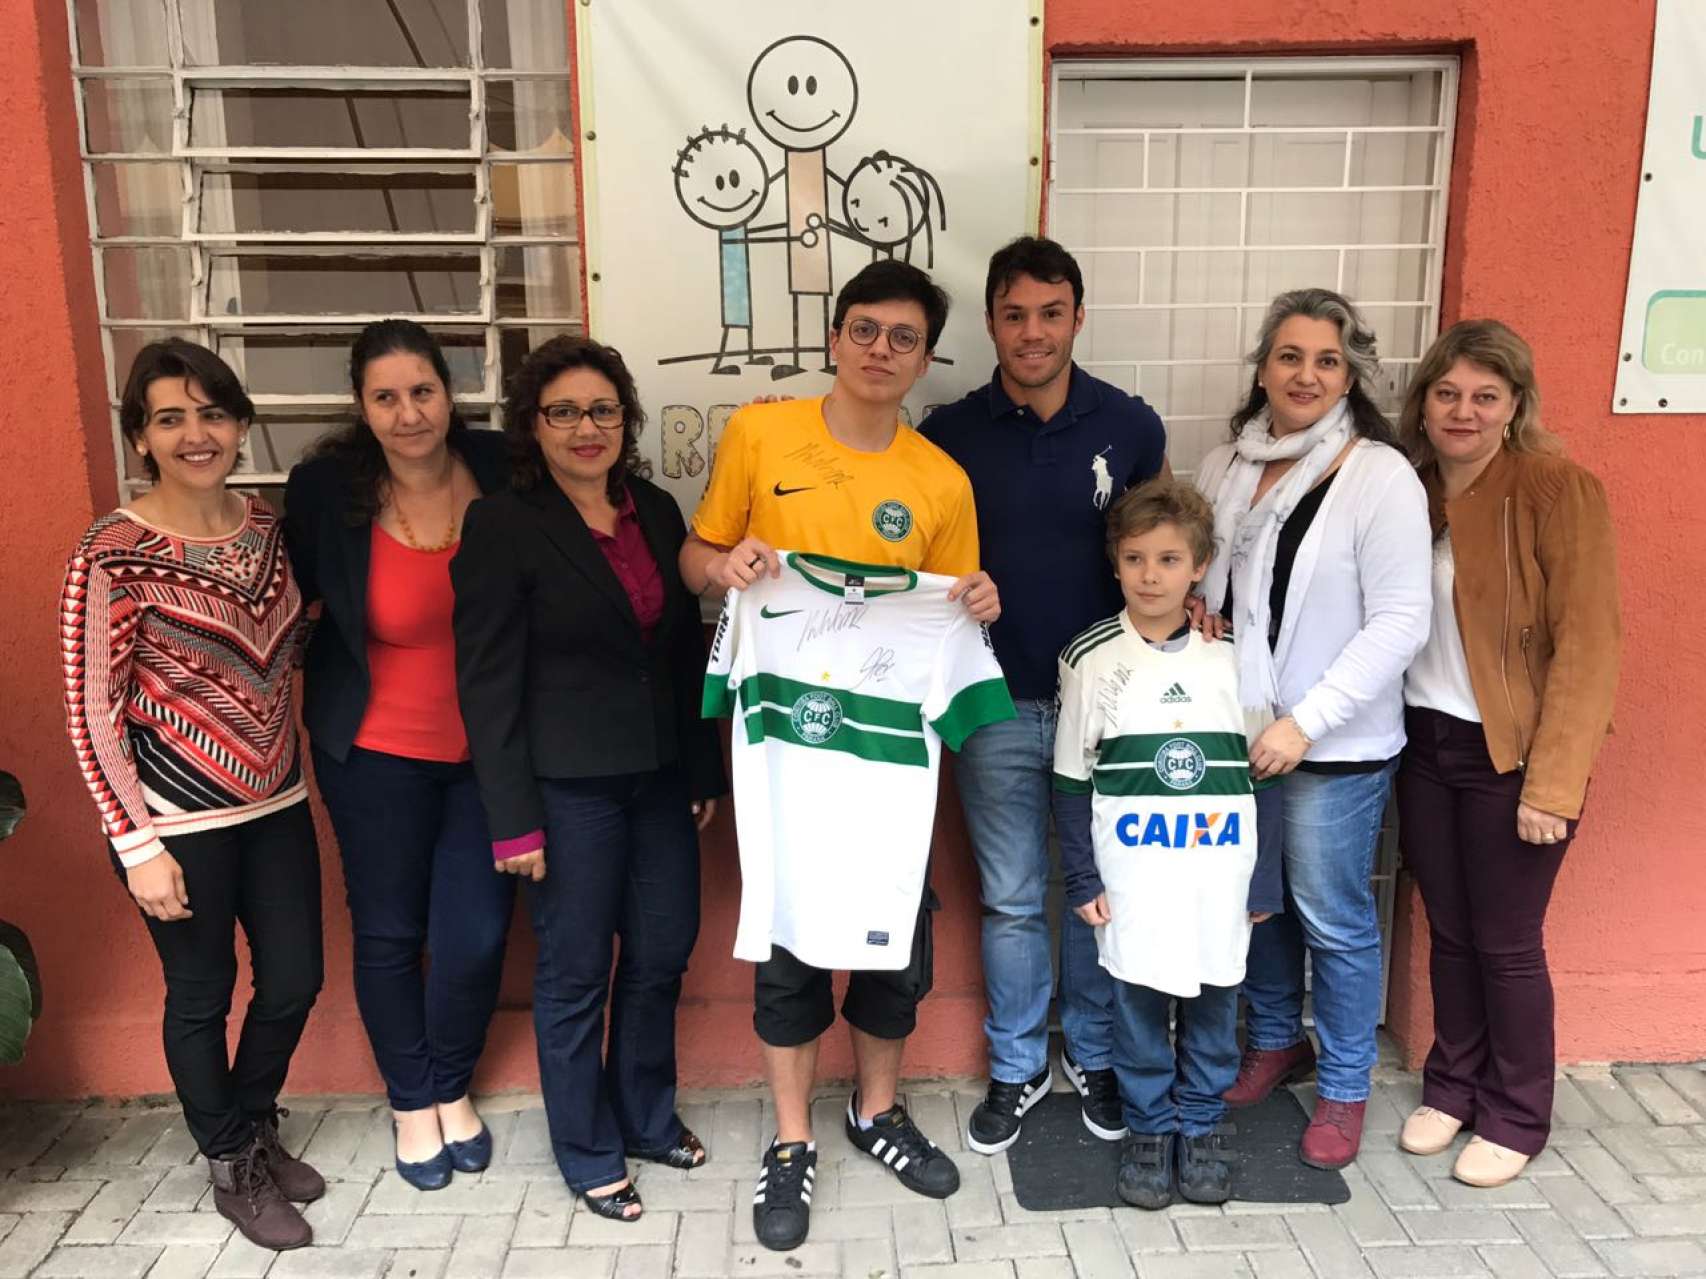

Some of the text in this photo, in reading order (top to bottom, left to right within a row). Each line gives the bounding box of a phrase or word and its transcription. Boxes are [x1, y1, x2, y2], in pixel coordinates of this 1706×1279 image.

[1159, 695, 1193, 704] adidas
[803, 709, 831, 726] CFC
[1167, 757, 1195, 772] CFC
[1115, 811, 1241, 849] CAIXA
